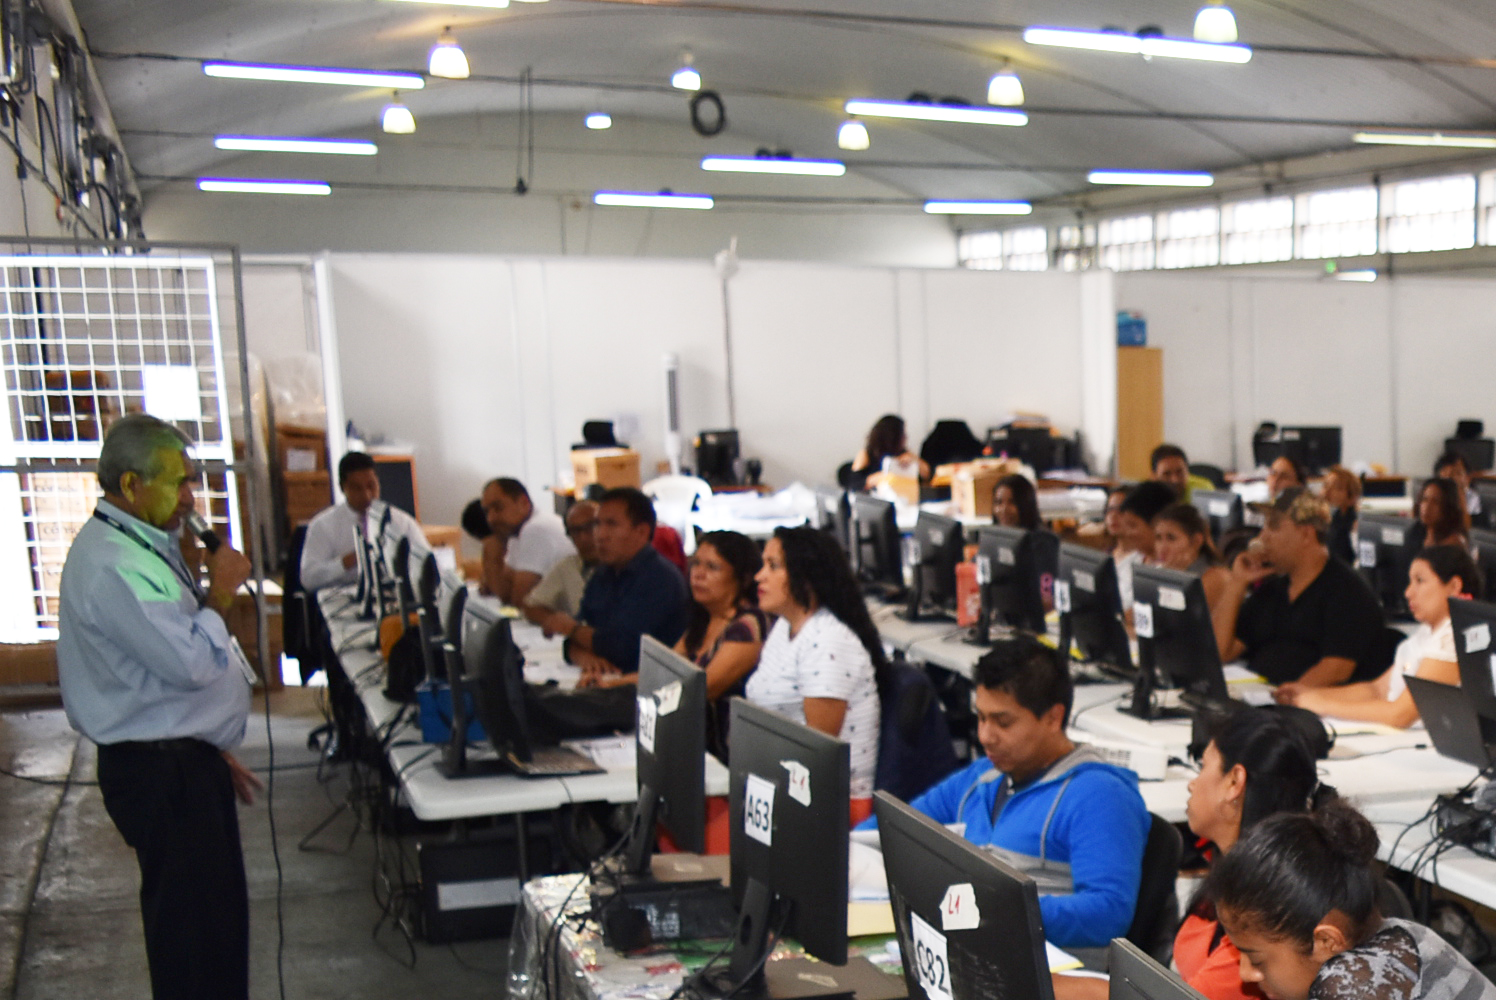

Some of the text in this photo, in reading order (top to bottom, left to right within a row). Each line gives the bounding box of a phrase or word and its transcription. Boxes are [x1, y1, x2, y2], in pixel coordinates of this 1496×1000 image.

[746, 793, 770, 832] A63
[948, 893, 961, 915] L1
[916, 940, 950, 996] C82
